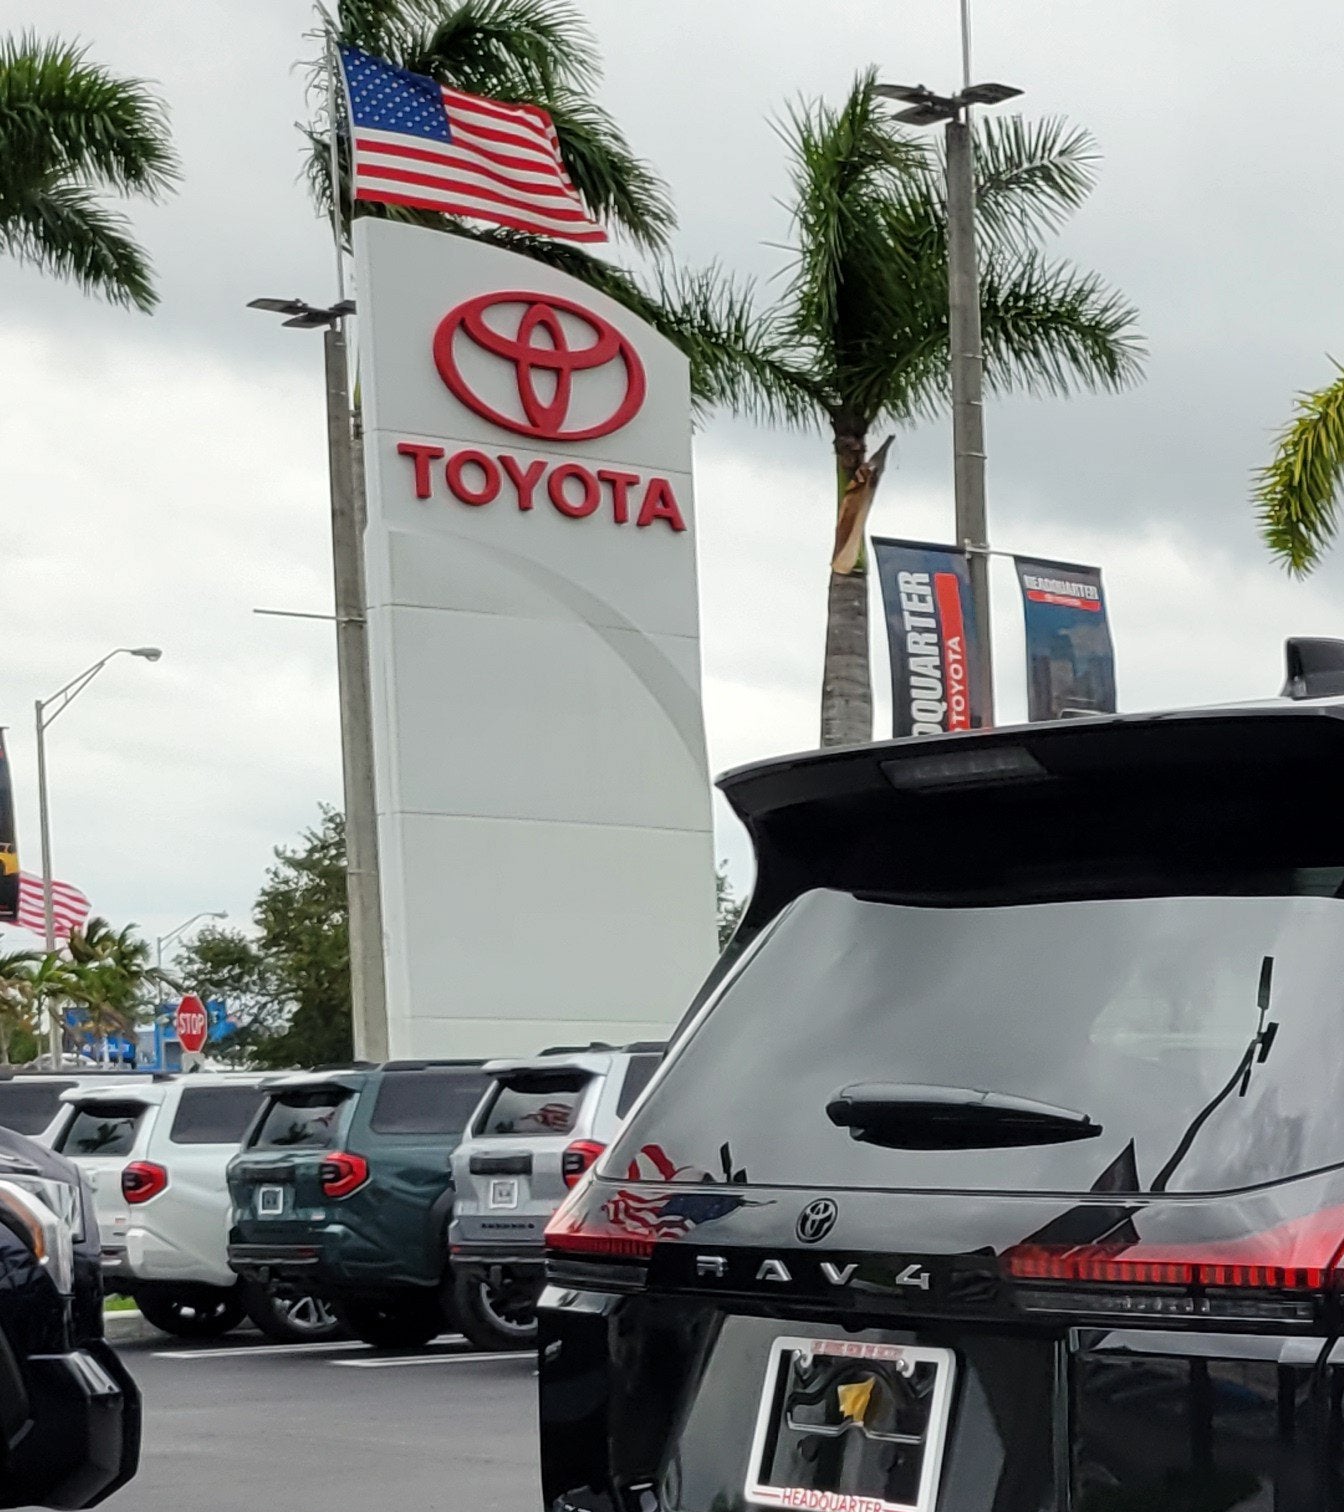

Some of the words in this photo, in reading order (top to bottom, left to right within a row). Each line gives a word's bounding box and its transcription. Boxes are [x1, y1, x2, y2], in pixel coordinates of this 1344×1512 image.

[397, 442, 687, 532] TOYOTA
[947, 636, 966, 727] TOYOTA
[179, 1012, 204, 1035] STOP
[696, 1255, 930, 1290] RAV4
